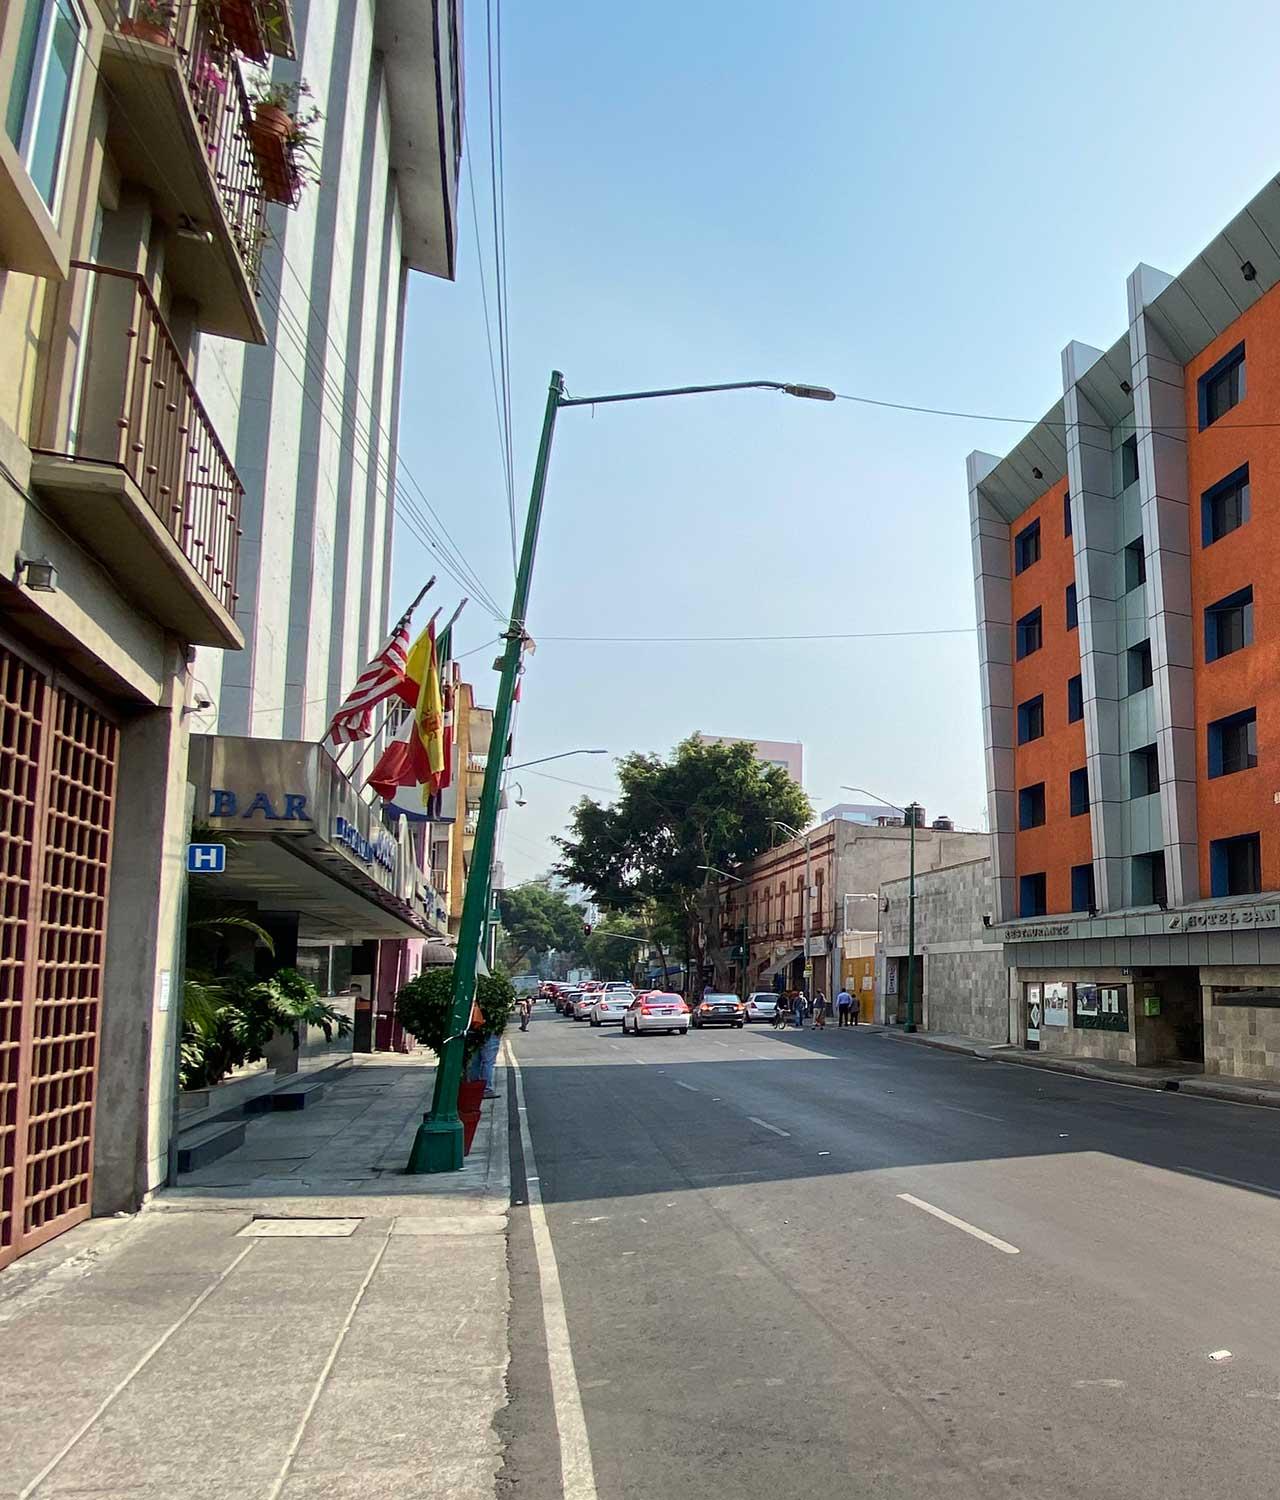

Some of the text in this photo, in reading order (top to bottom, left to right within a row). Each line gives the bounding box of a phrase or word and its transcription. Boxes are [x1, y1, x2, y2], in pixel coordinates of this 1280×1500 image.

[209, 790, 313, 821] BAR
[194, 848, 217, 868] H
[1187, 912, 1239, 927] HOTEL
[1242, 909, 1276, 923] SAN
